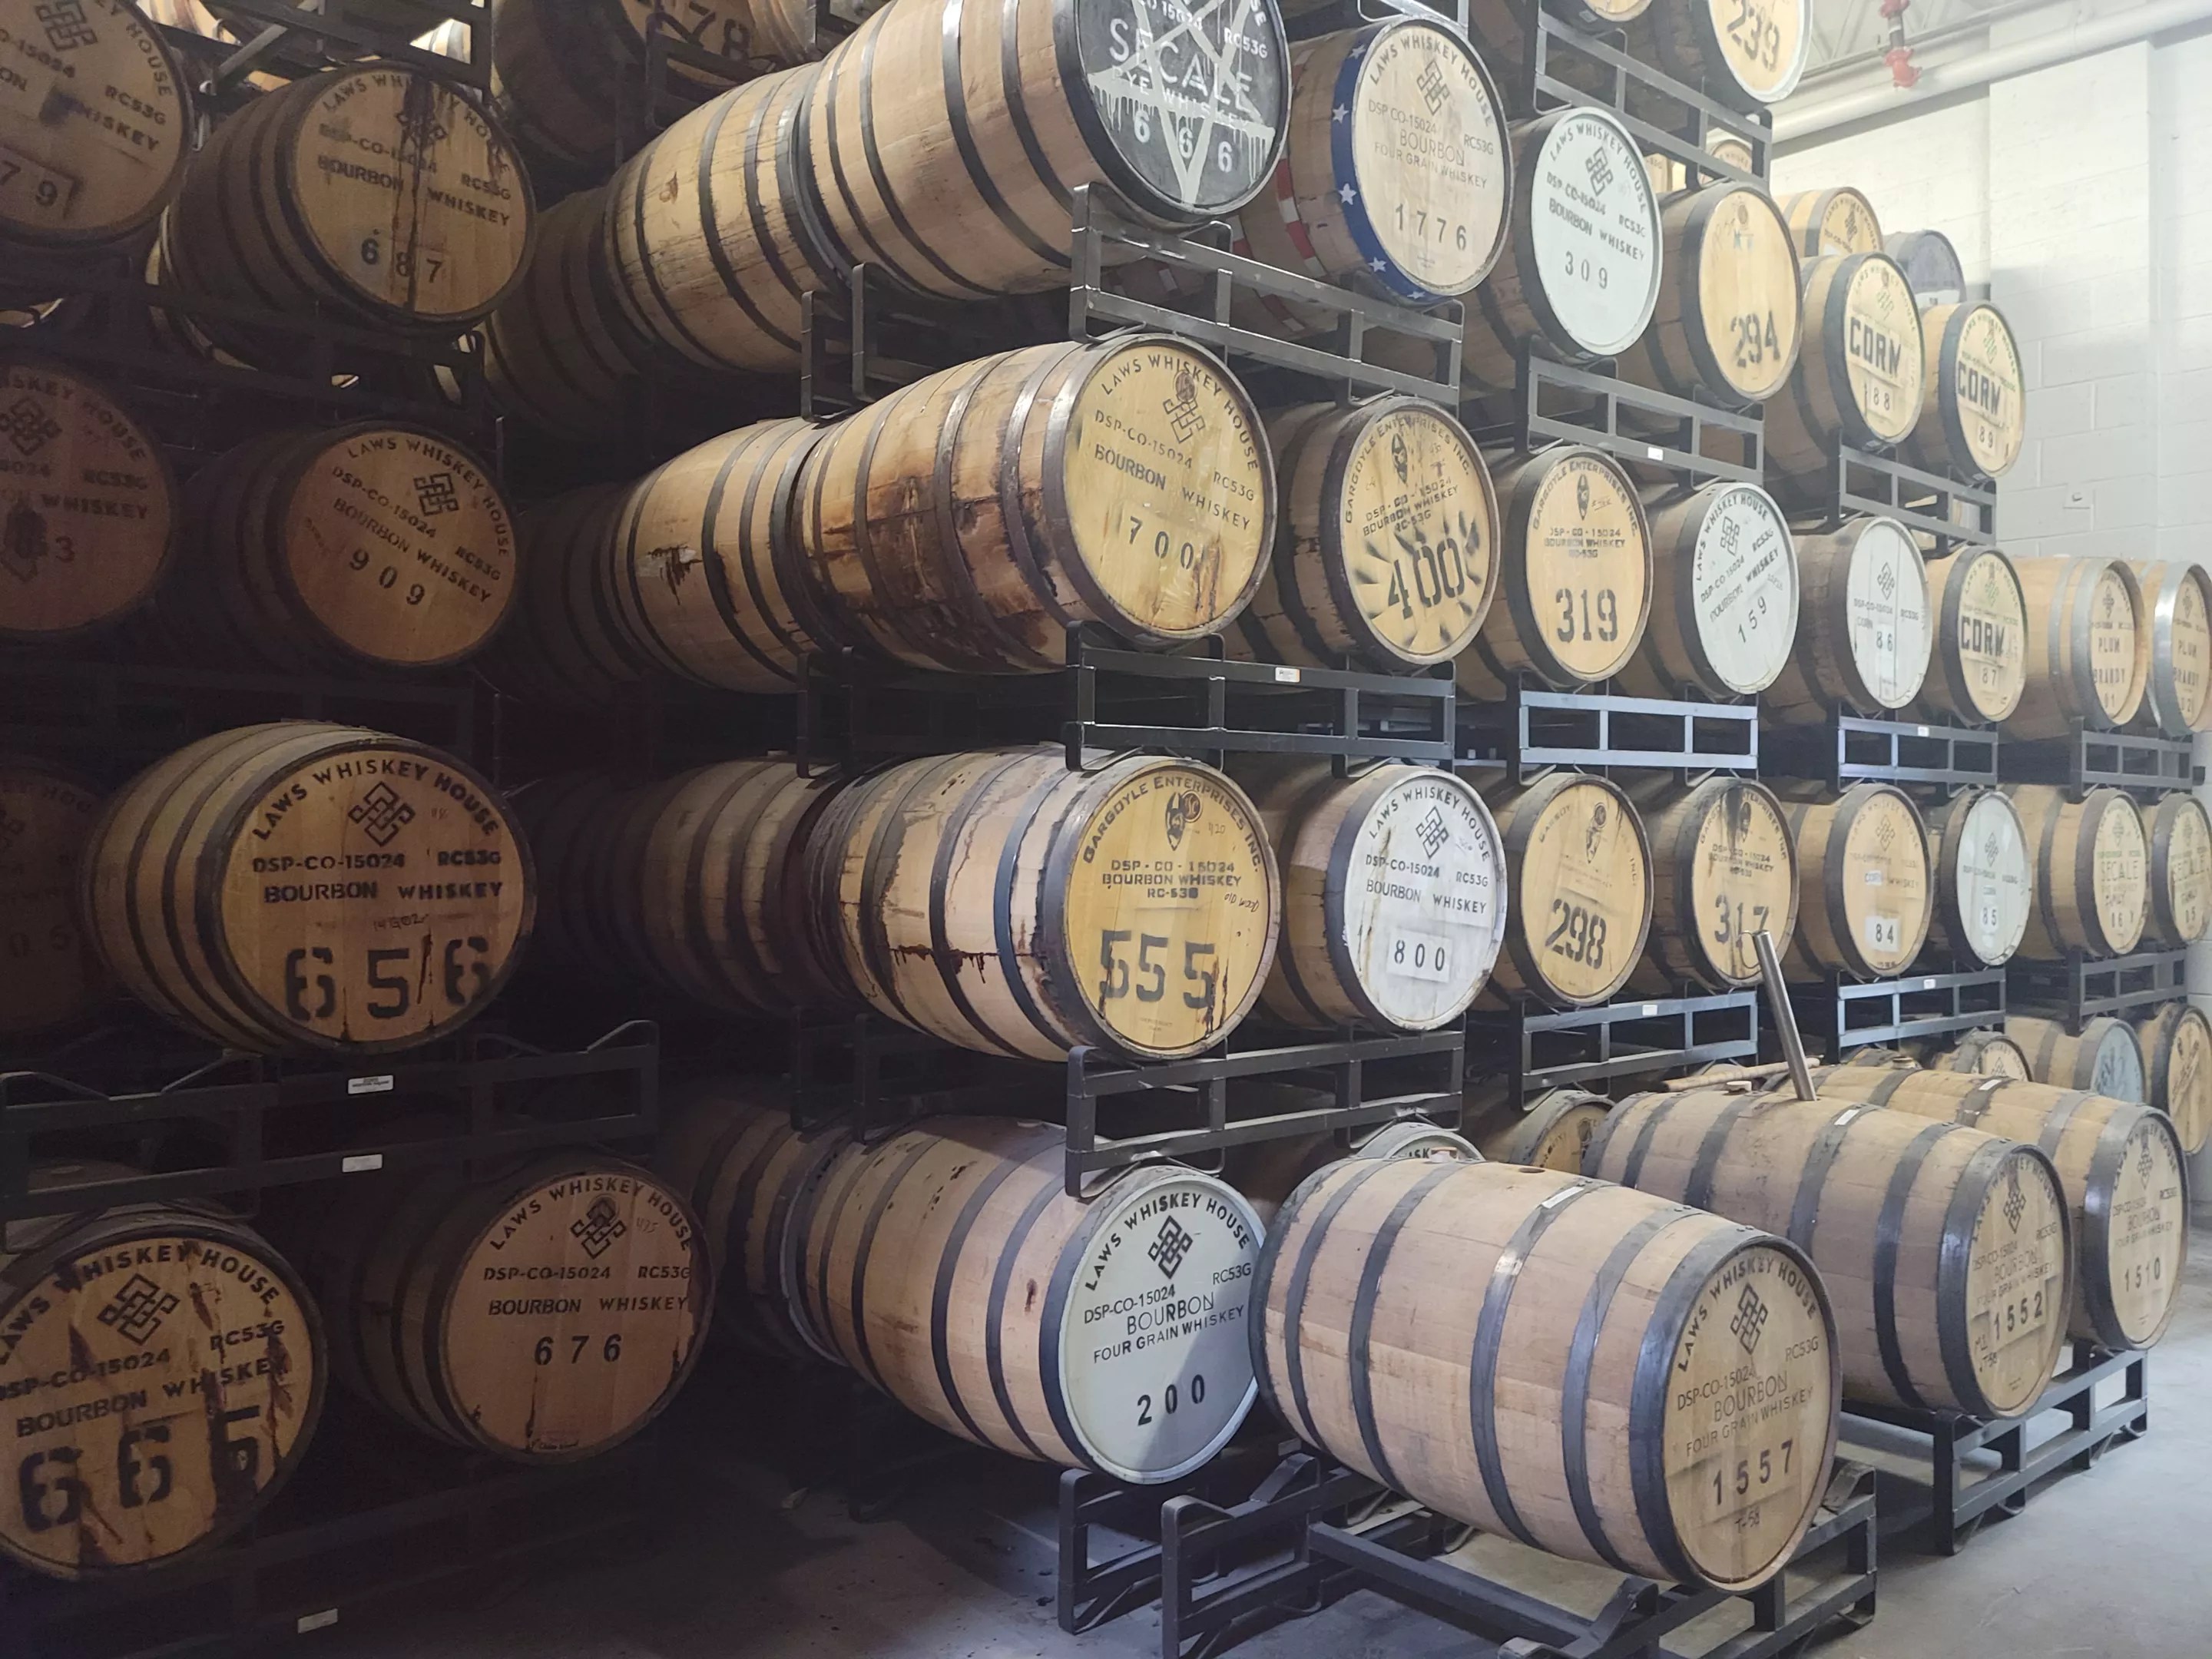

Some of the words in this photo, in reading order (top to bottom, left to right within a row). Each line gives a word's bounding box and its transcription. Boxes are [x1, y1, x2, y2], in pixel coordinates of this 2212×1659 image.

[125, 22, 173, 97] HOUSE
[1224, 28, 1267, 58] RC53G
[322, 78, 368, 112] LAWS
[1369, 46, 1398, 84] LAWS
[1402, 35, 1459, 66] WHISKEY
[1461, 67, 1492, 127] HOUSE
[1134, 107, 1233, 173] 666
[1374, 141, 1403, 162] FOUR
[1406, 153, 1439, 174] GRAIN
[1440, 164, 1487, 189] WHISKEY
[1399, 129, 1465, 167] BOURBON
[1464, 134, 1494, 156] RC53G
[1550, 127, 1574, 161] LAWS
[1576, 122, 1623, 156] WHISKEY
[1624, 156, 1647, 214] HOUSE
[317, 155, 405, 191] BOURBON
[427, 187, 510, 226] WHISKEY
[1395, 203, 1467, 252] 1776
[1549, 197, 1592, 236] BOURBON
[1599, 228, 1644, 262] WHISKEY
[361, 238, 443, 283] 687
[1565, 250, 1608, 290] 309
[1730, 310, 1780, 370] 294
[1849, 316, 1901, 376] CORN
[1101, 358, 1142, 396] LAWS
[1147, 353, 1224, 397] WHISKEY
[1224, 399, 1258, 472] HOUSE
[1873, 387, 1891, 411] 88
[1959, 359, 2001, 416] CORN
[1094, 409, 1194, 470] DSP-CO-15024
[1213, 471, 1255, 502] RC53G
[1979, 426, 1994, 448] 89
[332, 466, 437, 538] DSP-CO-15024
[347, 437, 397, 459] LAWS
[406, 439, 485, 492] WHISKEY
[482, 495, 510, 558] HOUSE
[1094, 443, 1167, 492] BOURBON
[1180, 488, 1251, 531] WHISKEY
[1345, 432, 1375, 524] GARGOYLE
[1532, 468, 1568, 531] GARGOYLE
[1568, 460, 1627, 504] ENTERPRISES
[1362, 506, 1411, 537] BOURBON
[1412, 484, 1459, 511] WHISKEY
[1696, 540, 1707, 581] LAWS
[1704, 494, 1738, 534] WHISKEY
[1740, 492, 1768, 522] HOUSE
[333, 498, 411, 554] BOURBON
[416, 548, 492, 604] WHISKEY
[1128, 515, 1195, 571] 700
[1586, 538, 1626, 548] WHISKEY
[349, 548, 426, 605] 909
[1388, 537, 1465, 621] 400
[1709, 582, 1744, 624] BOURBON
[1745, 546, 1780, 584] WHISKEY
[1555, 587, 1618, 643] 319
[1737, 594, 1768, 644] 159
[1876, 630, 1894, 652] 86
[1961, 614, 2005, 657] CORN
[2098, 636, 2120, 654] PLUM
[1982, 666, 1997, 687] 87
[252, 782, 308, 841] LAWS
[312, 758, 429, 786] WHISKEY
[433, 772, 499, 836] HOUSE
[1081, 783, 1150, 865] GARGOYLE
[1153, 775, 1247, 833] ENTERPRISES
[1244, 832, 1262, 873] INC.
[1369, 803, 1399, 839] LAWS
[1402, 786, 1460, 809] WHISKEY
[1461, 808, 1490, 862] HOUSE
[252, 853, 406, 874] DSP-CO-15024
[436, 849, 502, 868] RC53G
[1102, 873, 1174, 886] BOURBON
[1177, 873, 1243, 887] WHISKEY
[1111, 860, 1142, 873] DSP
[1187, 860, 1235, 873] 15024
[1365, 854, 1440, 878] DSP-CO-15024
[1455, 871, 1488, 887] RC53G
[263, 880, 379, 905] BOURBON
[398, 880, 504, 902] WHISKEY
[1366, 879, 1421, 902] BOURBON
[1432, 893, 1487, 914] WHISKEY
[1982, 907, 1997, 926] 85
[1393, 939, 1445, 972] 800
[1545, 898, 1607, 970] 298
[1876, 923, 1894, 944] 84
[284, 935, 493, 1022] 656
[1098, 929, 1216, 1012] 555
[490, 1199, 542, 1250] LAWS
[549, 1177, 644, 1202] WHISKEY
[647, 1194, 690, 1251] HOUSE
[1084, 1233, 1122, 1292] LAWS
[1124, 1192, 1202, 1230] WHISKEY
[1206, 1196, 1250, 1250] HOUSE
[482, 1267, 611, 1280] DSP-CO-15024
[637, 1266, 690, 1280] RC53G
[1084, 1283, 1176, 1325] DSP-CO-15024
[1212, 1262, 1252, 1286] RC53G
[2124, 1255, 2169, 1293] 1510
[0, 1296, 51, 1366] LAWS
[202, 1249, 280, 1305] HOUSE
[488, 1299, 581, 1316] BOURBON
[598, 1296, 689, 1311] WHISKEY
[1093, 1336, 1132, 1364] FOUR
[1136, 1322, 1179, 1349] GRAIN
[1182, 1304, 1244, 1335] WHISKEY
[1127, 1293, 1214, 1336] BOURBON
[1677, 1307, 1708, 1373] LAWS
[1709, 1256, 1773, 1301] WHISKEY
[1777, 1261, 1816, 1320] HOUSE
[1994, 1289, 2043, 1340] 1552
[210, 1320, 285, 1351] RC53G
[534, 1334, 623, 1366] 676
[1136, 1374, 1206, 1427] 200
[1677, 1363, 1756, 1411] DSP-CO-15024
[1785, 1336, 1820, 1363] RC53G
[1714, 1370, 1788, 1422] BOURBON
[17, 1389, 148, 1439] BOURBON
[1686, 1429, 1719, 1458] FOUR
[1721, 1409, 1760, 1440] GRAIN
[1760, 1385, 1815, 1422] WHISKEY
[1713, 1439, 1794, 1505] 1557
